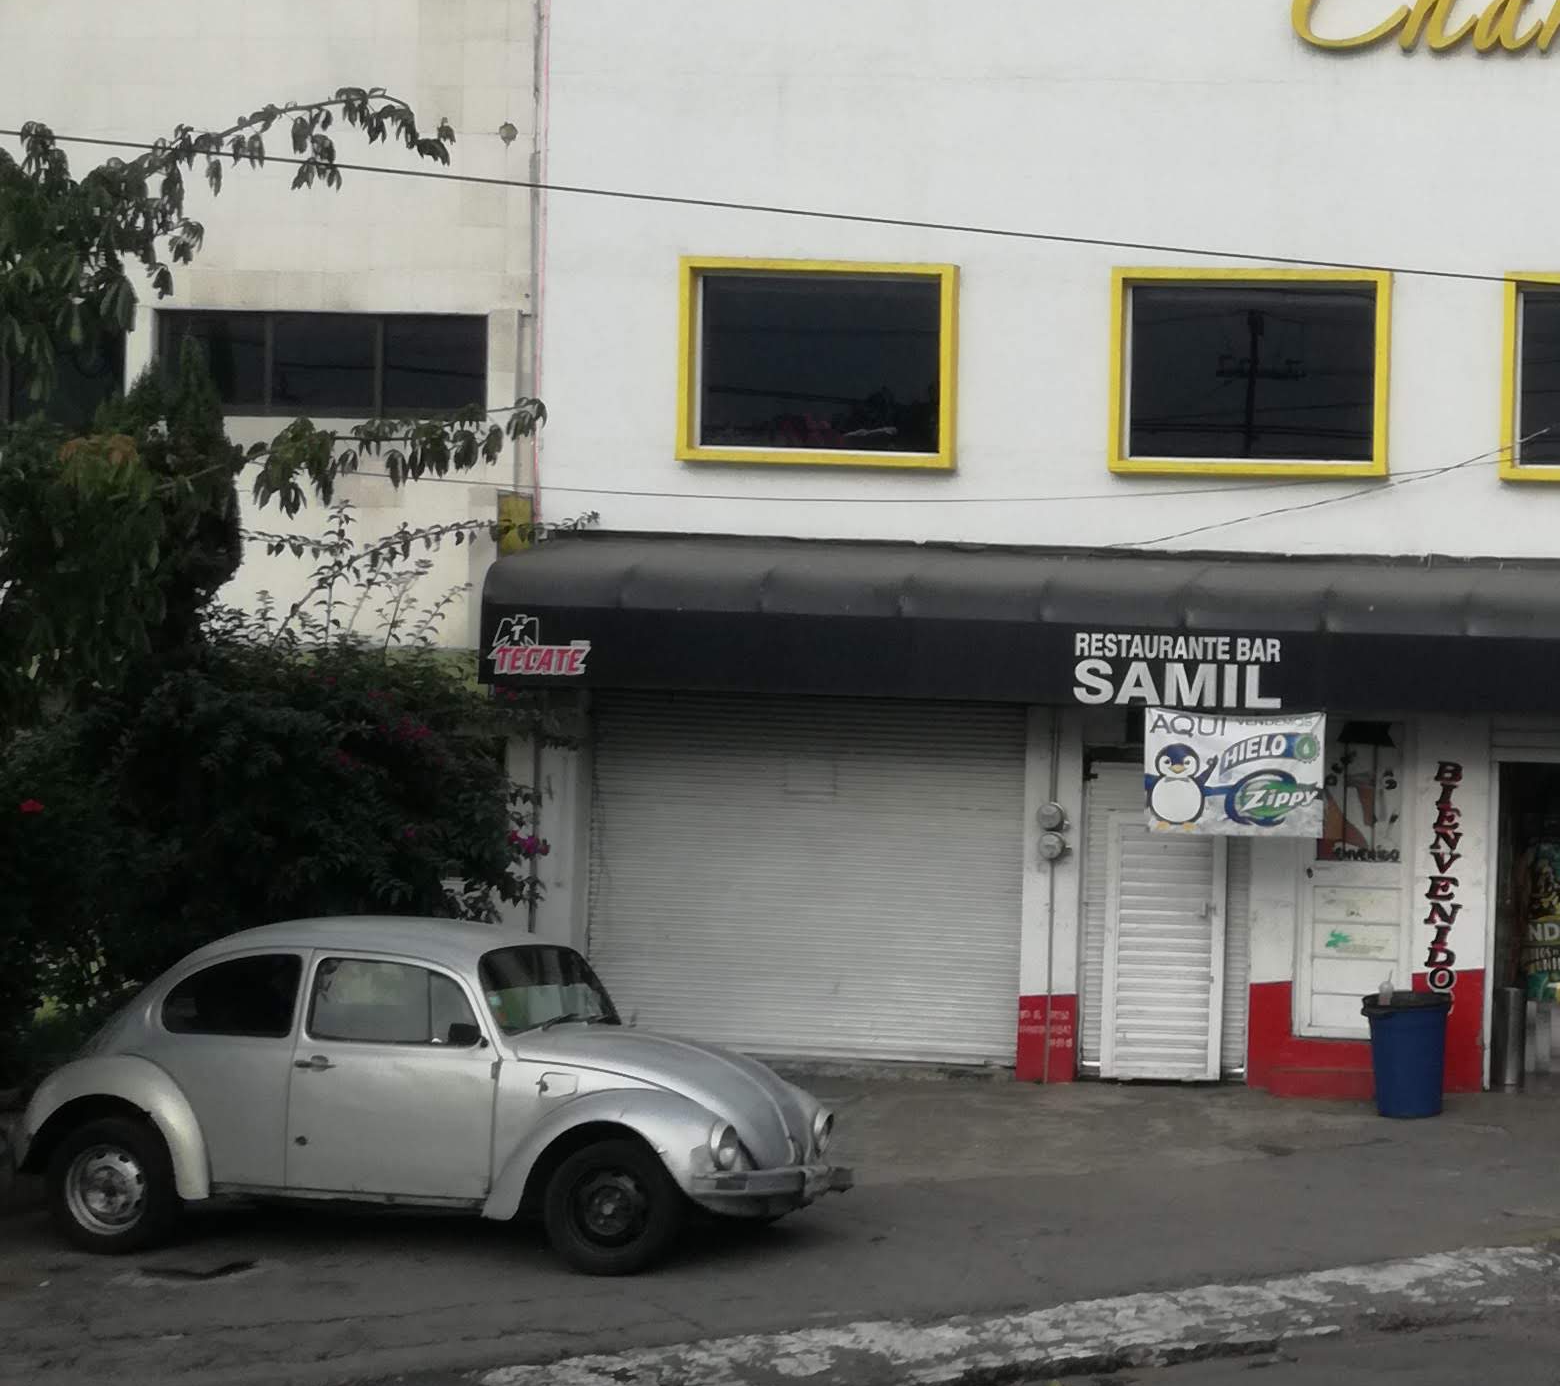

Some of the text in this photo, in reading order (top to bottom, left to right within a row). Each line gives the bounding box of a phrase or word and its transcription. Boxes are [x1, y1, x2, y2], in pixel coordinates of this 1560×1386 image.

[493, 645, 589, 674] TECATE
[1074, 632, 1281, 663] RESTAURANTE BAR
[1072, 658, 1282, 710] SAMIL
[1149, 713, 1227, 738] AQUI
[1224, 734, 1288, 768] HIELO
[1241, 788, 1319, 812] Zippy
